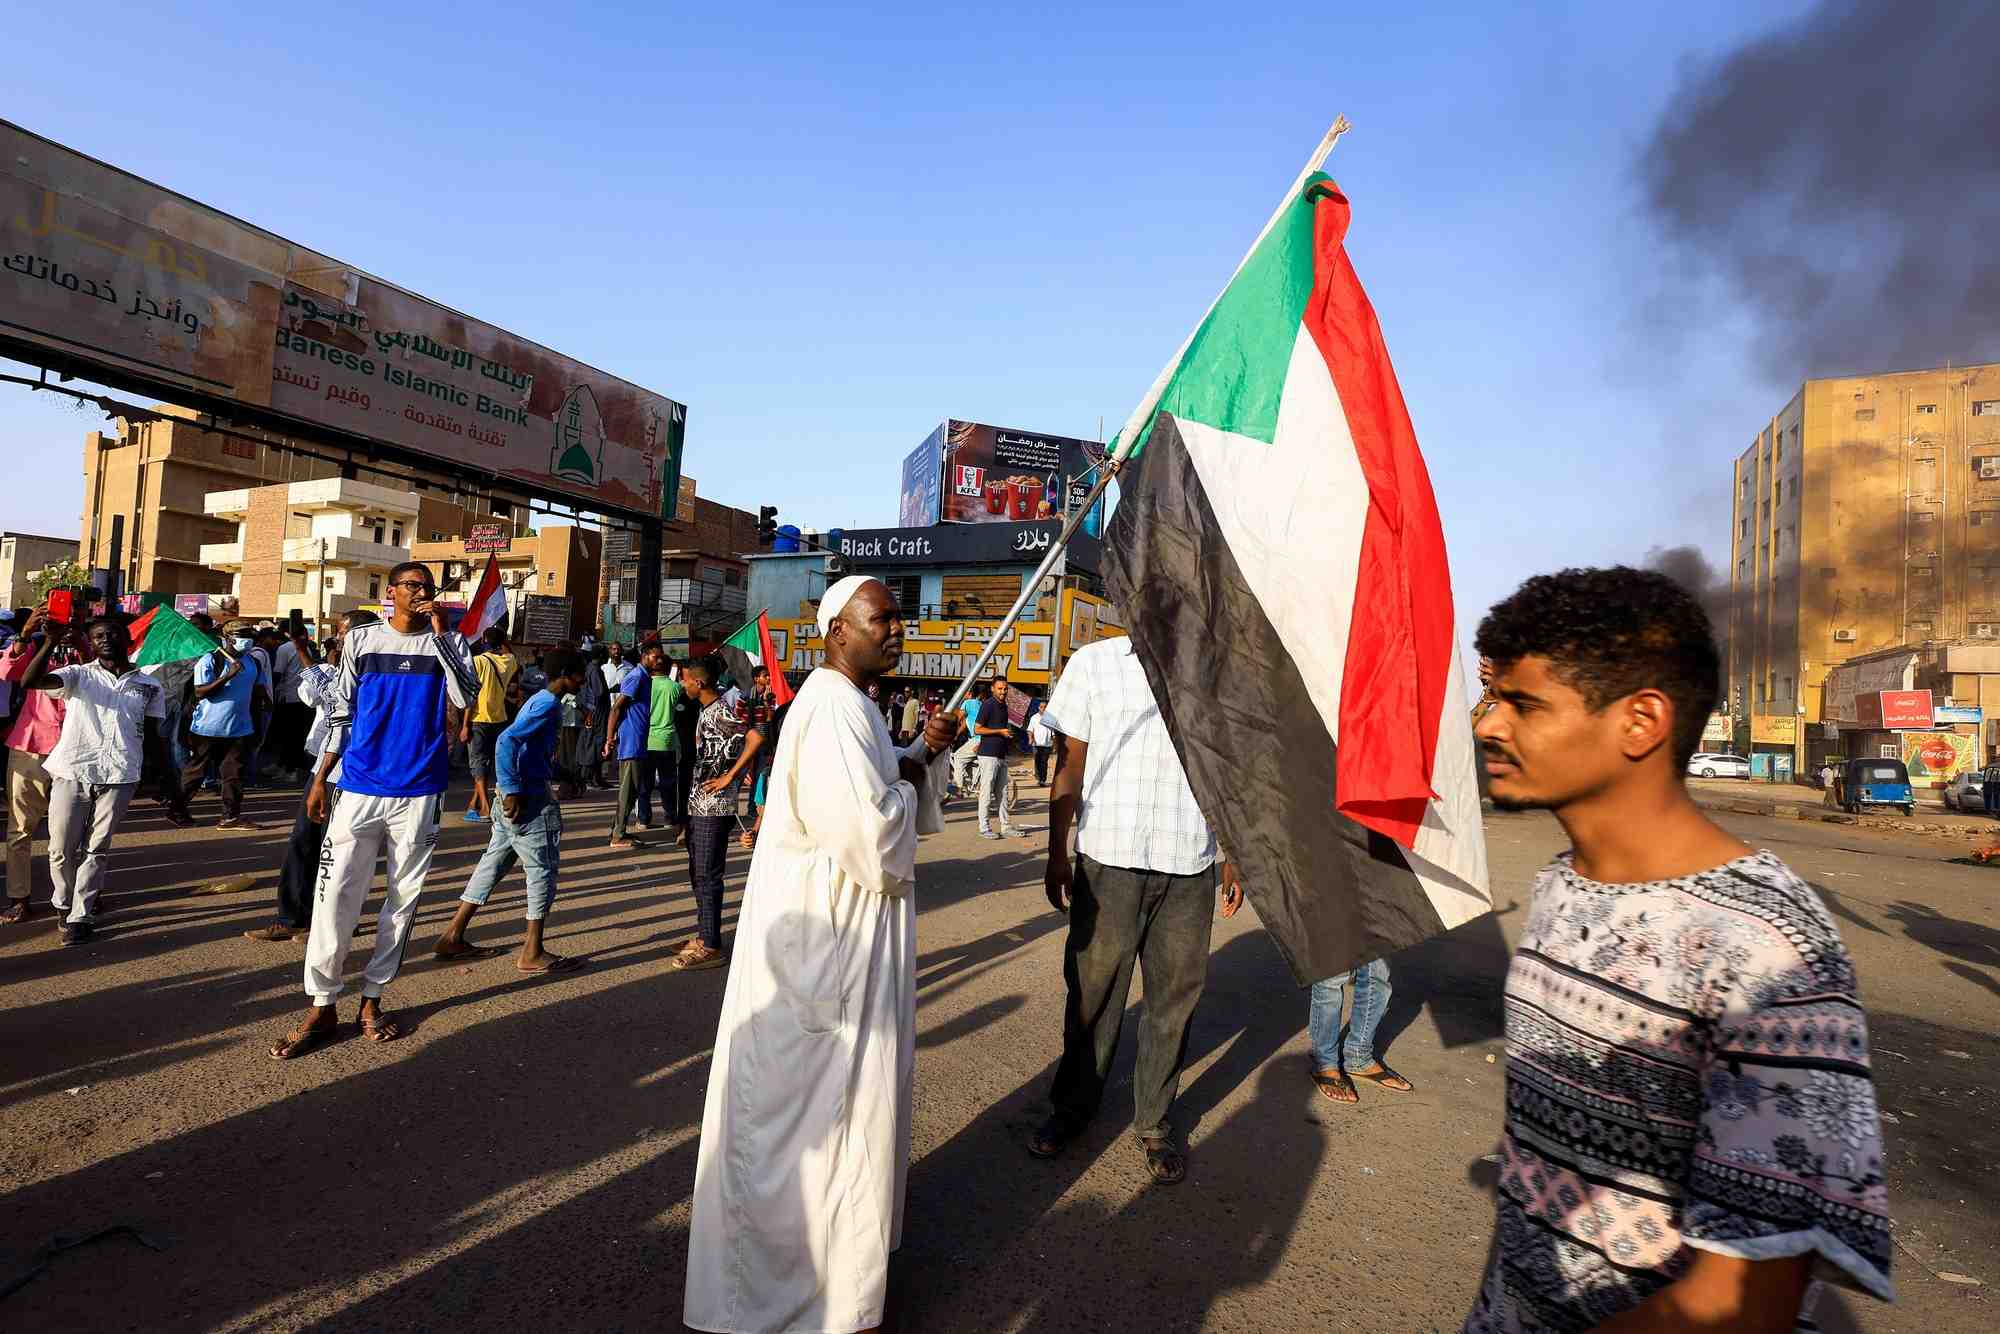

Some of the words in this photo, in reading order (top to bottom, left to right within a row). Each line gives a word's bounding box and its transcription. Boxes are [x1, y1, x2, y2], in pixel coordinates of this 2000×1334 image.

[3, 254, 117, 304] خدماتك
[125, 289, 198, 334] وأنجز
[326, 384, 370, 409] وقيم
[383, 362, 469, 408] Islamic
[476, 393, 529, 427] Bank
[405, 404, 463, 435] متقدمة
[468, 422, 507, 448] تقنية
[997, 433, 1033, 447] رمضان
[1034, 440, 1060, 450] عرض
[959, 487, 977, 496] KFC
[841, 538, 882, 557] Black
[888, 536, 933, 556] Craft
